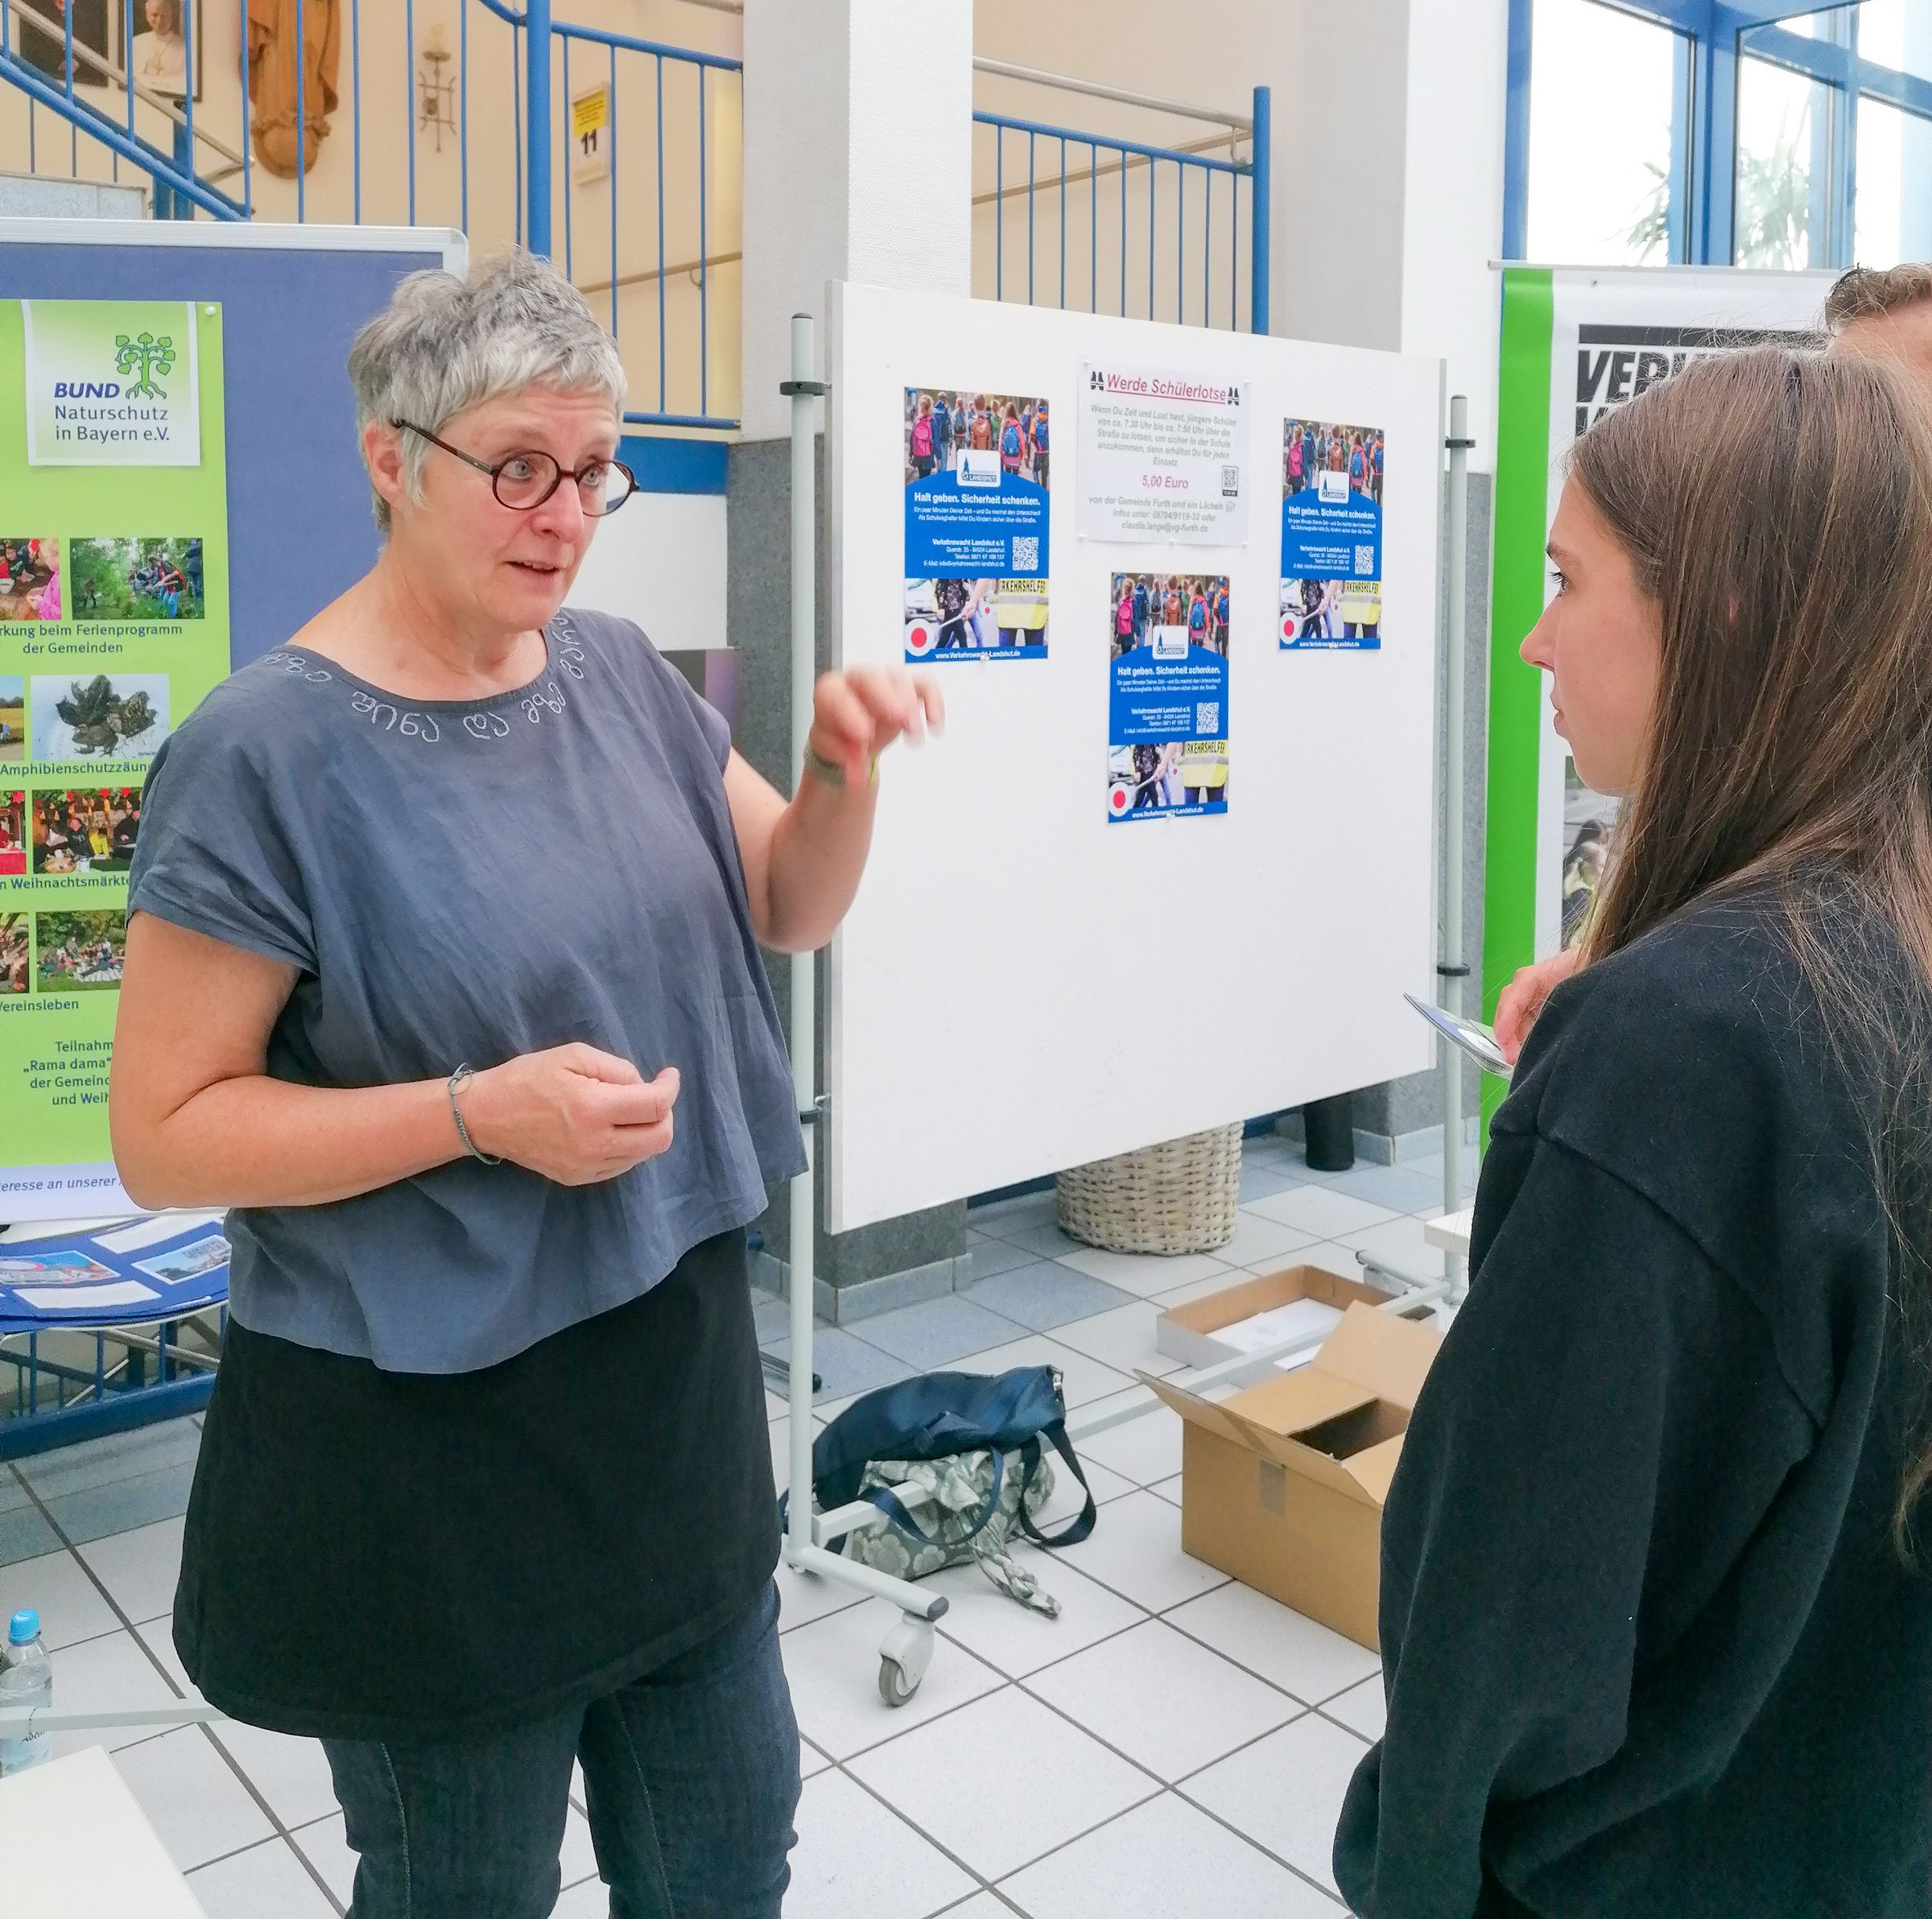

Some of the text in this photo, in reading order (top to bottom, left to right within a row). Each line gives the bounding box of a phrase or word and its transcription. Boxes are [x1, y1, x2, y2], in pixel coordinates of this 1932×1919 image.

[581, 129, 597, 155] 11
[1577, 350, 1689, 403] VER
[54, 382, 121, 398] BUND
[1107, 373, 1226, 401] Werde Schülerlotse
[55, 405, 168, 421] Naturschutz
[1091, 404, 1111, 413] Wenn
[1113, 406, 1122, 415] Du
[1124, 407, 1137, 417] Zeit
[1153, 411, 1168, 419] Lust
[1187, 414, 1212, 425] jüngere
[1213, 416, 1236, 426] Schüler
[56, 425, 170, 444] in Bayern e.V.
[1140, 420, 1152, 429] Uhr
[1154, 423, 1164, 431] bis
[1192, 426, 1204, 434] Uhr
[1206, 427, 1220, 435] über
[1096, 428, 1120, 439] Straße
[1167, 435, 1188, 444] sicher
[1190, 436, 1196, 445] in
[1198, 438, 1208, 446] der
[1146, 445, 1163, 453] dann
[1191, 448, 1201, 457] Du
[1153, 456, 1178, 466] Einsatz
[1142, 475, 1188, 489] 5,00 Euro
[914, 492, 931, 501] Halt
[961, 493, 1001, 504] Sicherheit
[1088, 496, 1103, 504] von
[1104, 496, 1116, 505] der
[1118, 496, 1151, 506] Gemeinde
[1153, 498, 1170, 507] Furth
[1172, 501, 1186, 509] und
[1187, 501, 1197, 509] ein
[1113, 508, 1130, 518] Infos
[1201, 514, 1216, 522] oder
[39, 624, 72, 636] beim
[76, 624, 183, 638] Ferienprogramm
[23, 642, 123, 654] der Gemeinden
[1156, 666, 1187, 675] Sicherheit
[1, 761, 151, 778] Amphibienschutzzäun
[56, 1038, 113, 1052] Teilnahm
[30, 1077, 52, 1089] der
[52, 1093, 76, 1105] und
[0, 1177, 116, 1192] eresse an unserer
